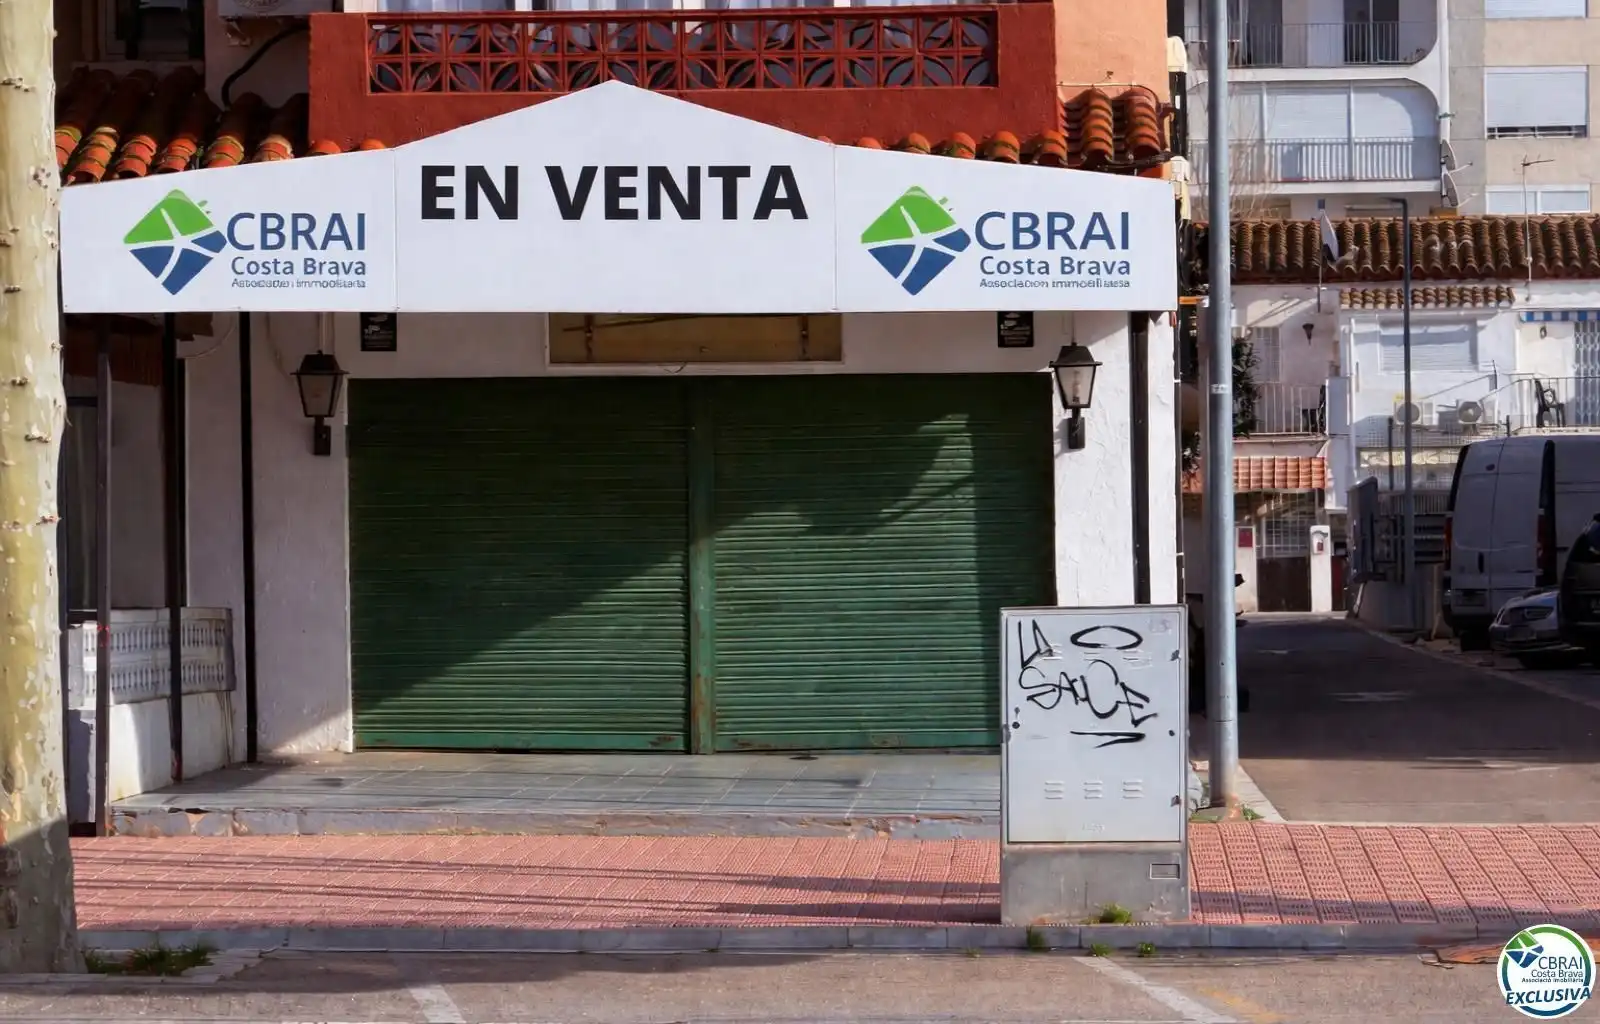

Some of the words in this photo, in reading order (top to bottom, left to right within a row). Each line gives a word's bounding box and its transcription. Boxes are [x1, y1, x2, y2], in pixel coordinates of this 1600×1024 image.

[421, 165, 519, 220] EN
[544, 165, 809, 221] VENTA
[227, 212, 366, 251] CBRAI
[974, 211, 1130, 250] CBRAI
[231, 256, 294, 275] Costa
[303, 257, 366, 276] Brava
[980, 256, 1050, 275] Costa
[1060, 256, 1130, 275] Brava
